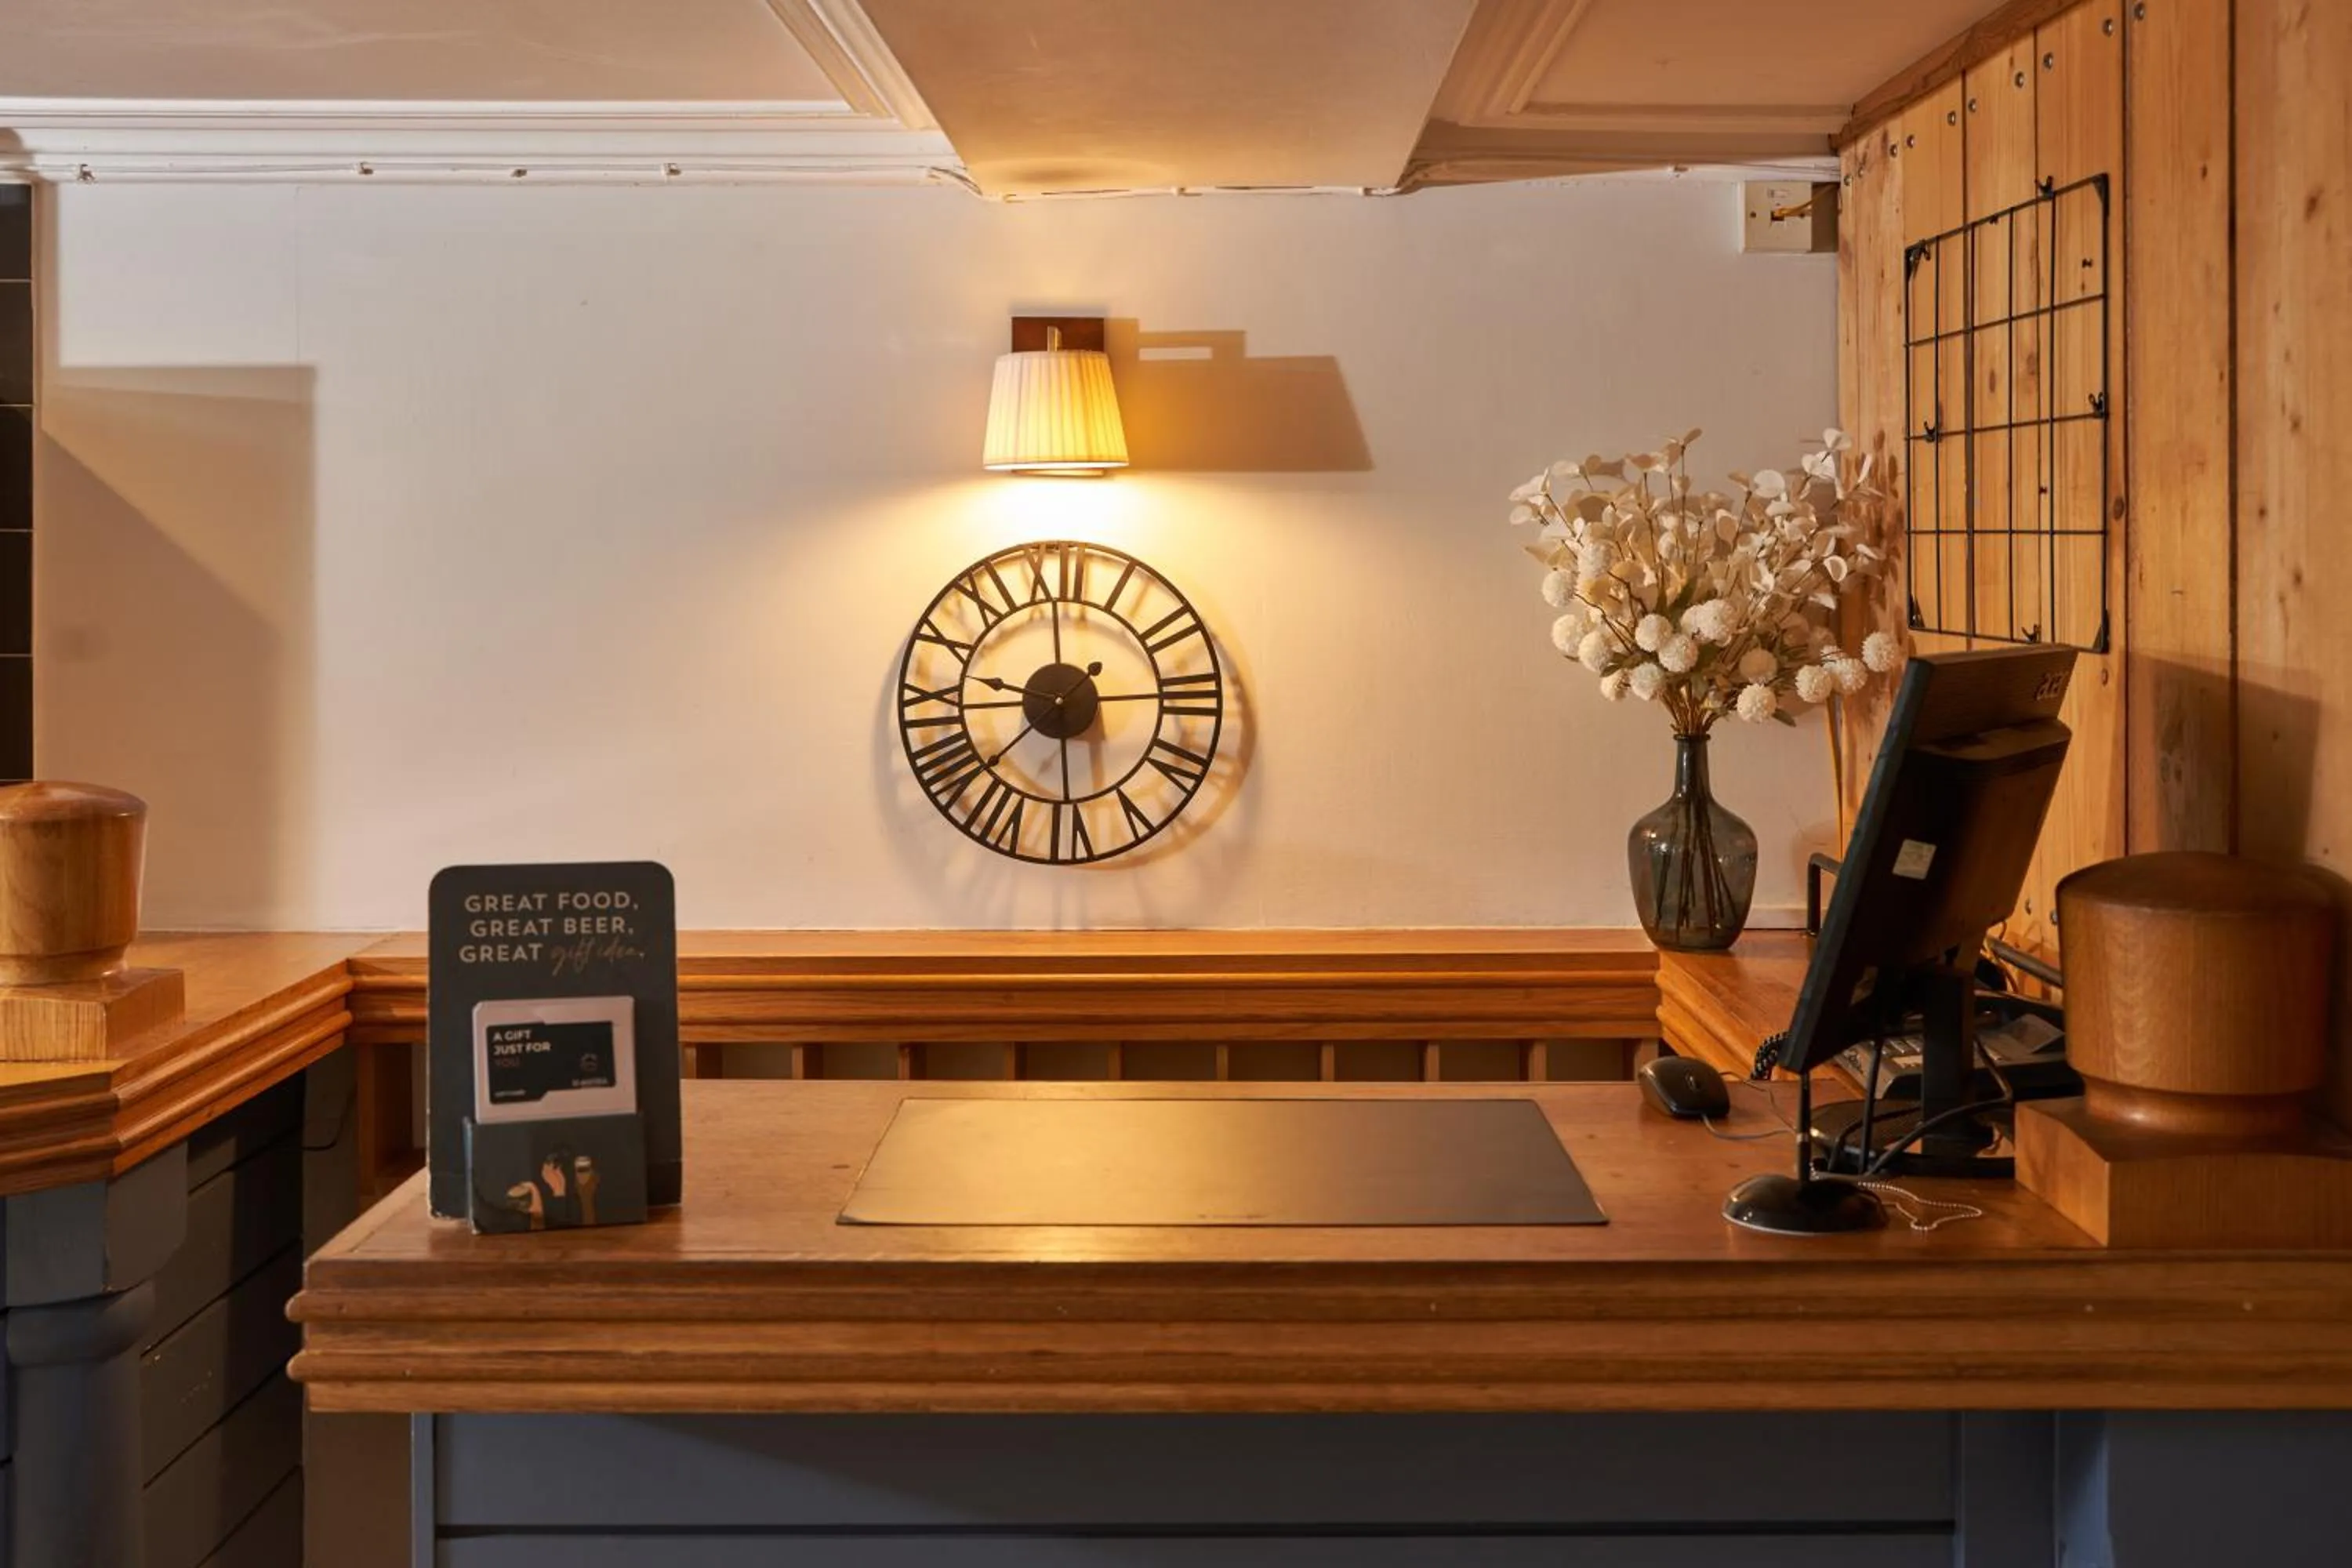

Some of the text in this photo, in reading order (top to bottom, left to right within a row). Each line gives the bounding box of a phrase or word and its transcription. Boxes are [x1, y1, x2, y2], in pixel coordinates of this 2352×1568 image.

[953, 560, 1016, 628] XI
[1024, 546, 1085, 601] XII
[1104, 560, 1138, 612] I
[913, 617, 974, 663] X
[1139, 603, 1204, 653] II
[903, 684, 962, 728] IX
[1160, 673, 1219, 717] III
[909, 731, 985, 810] VIII
[1146, 739, 1210, 794] IV
[964, 779, 1024, 855] VII
[1051, 803, 1095, 860] VI
[1116, 786, 1155, 840] V
[464, 894, 547, 913] GREAT
[470, 919, 552, 937] GREAT
[459, 943, 543, 963] GREAT
[493, 1030, 532, 1042] A GIFT
[493, 1042, 551, 1055] JUST FOR
